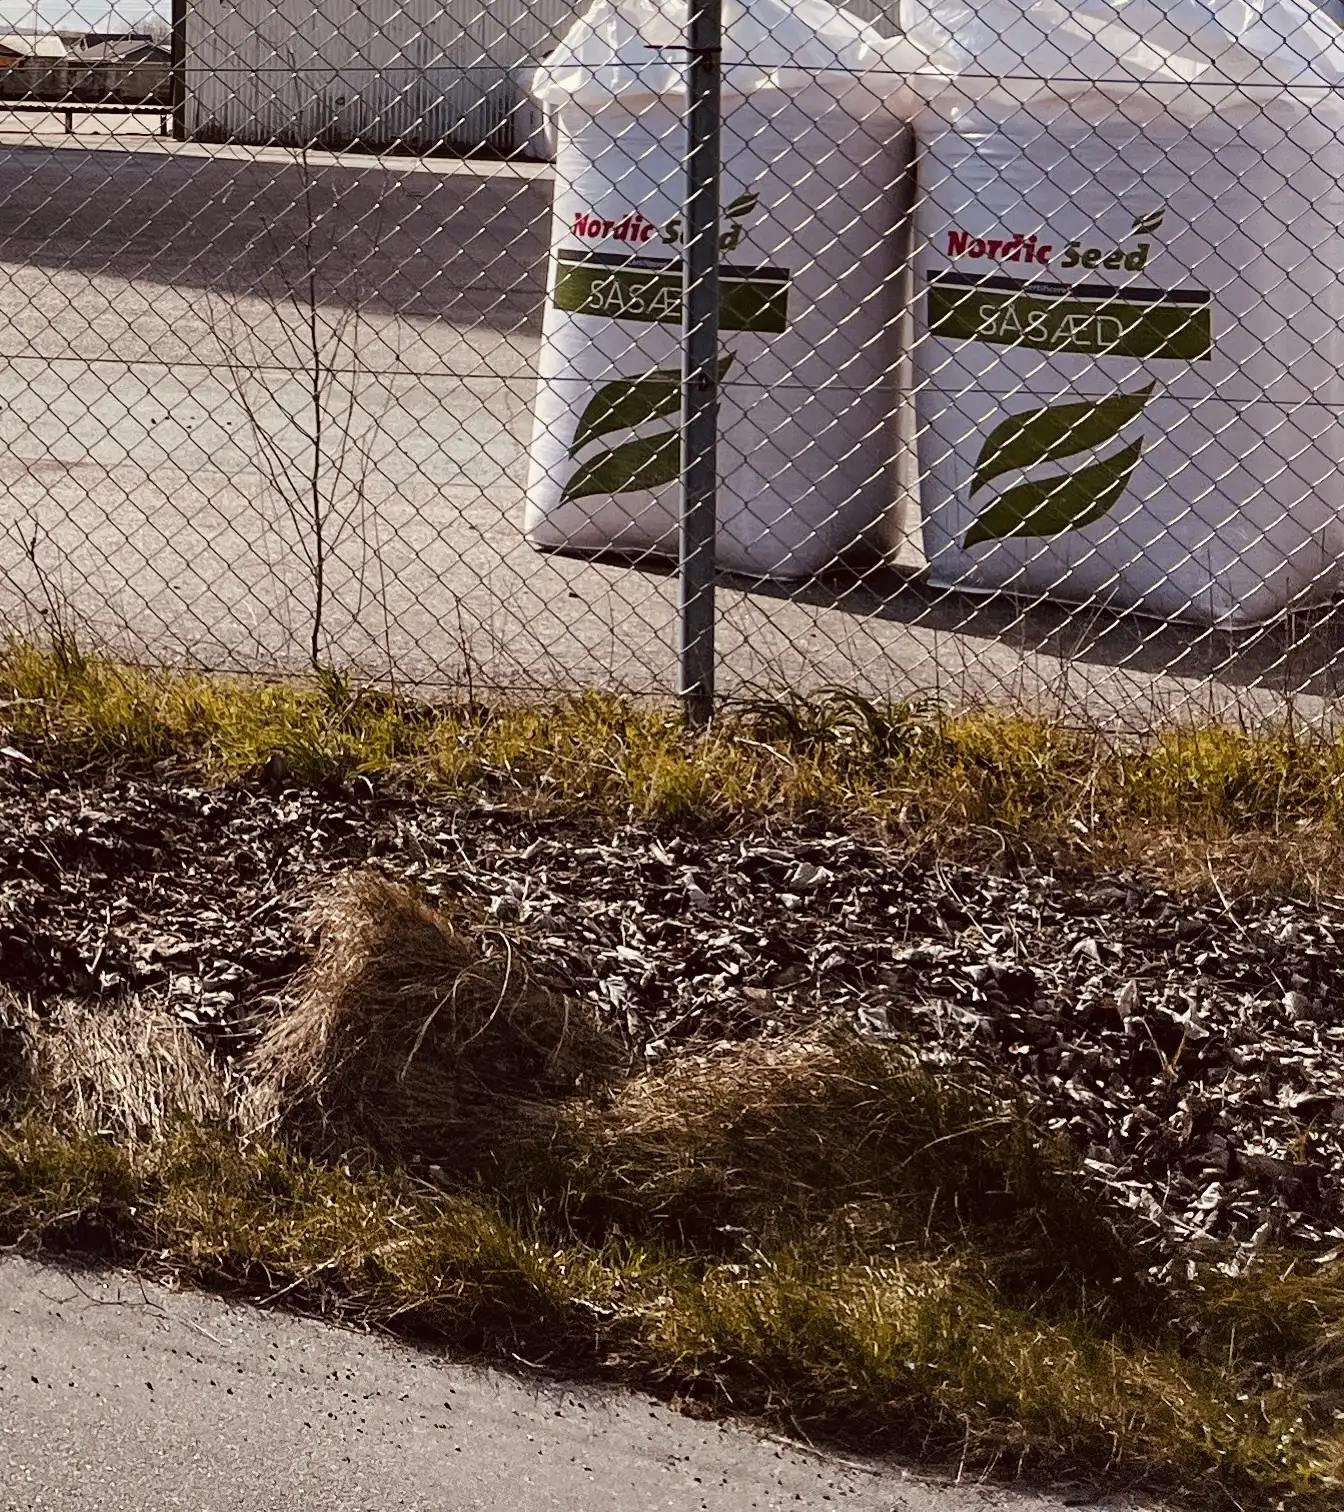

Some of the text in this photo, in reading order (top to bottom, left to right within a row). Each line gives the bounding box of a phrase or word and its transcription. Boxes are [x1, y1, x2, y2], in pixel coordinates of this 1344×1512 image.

[572, 212, 743, 251] Nordic Sd
[947, 230, 1151, 272] Nordic Seed
[588, 278, 684, 317] SÅSÆ
